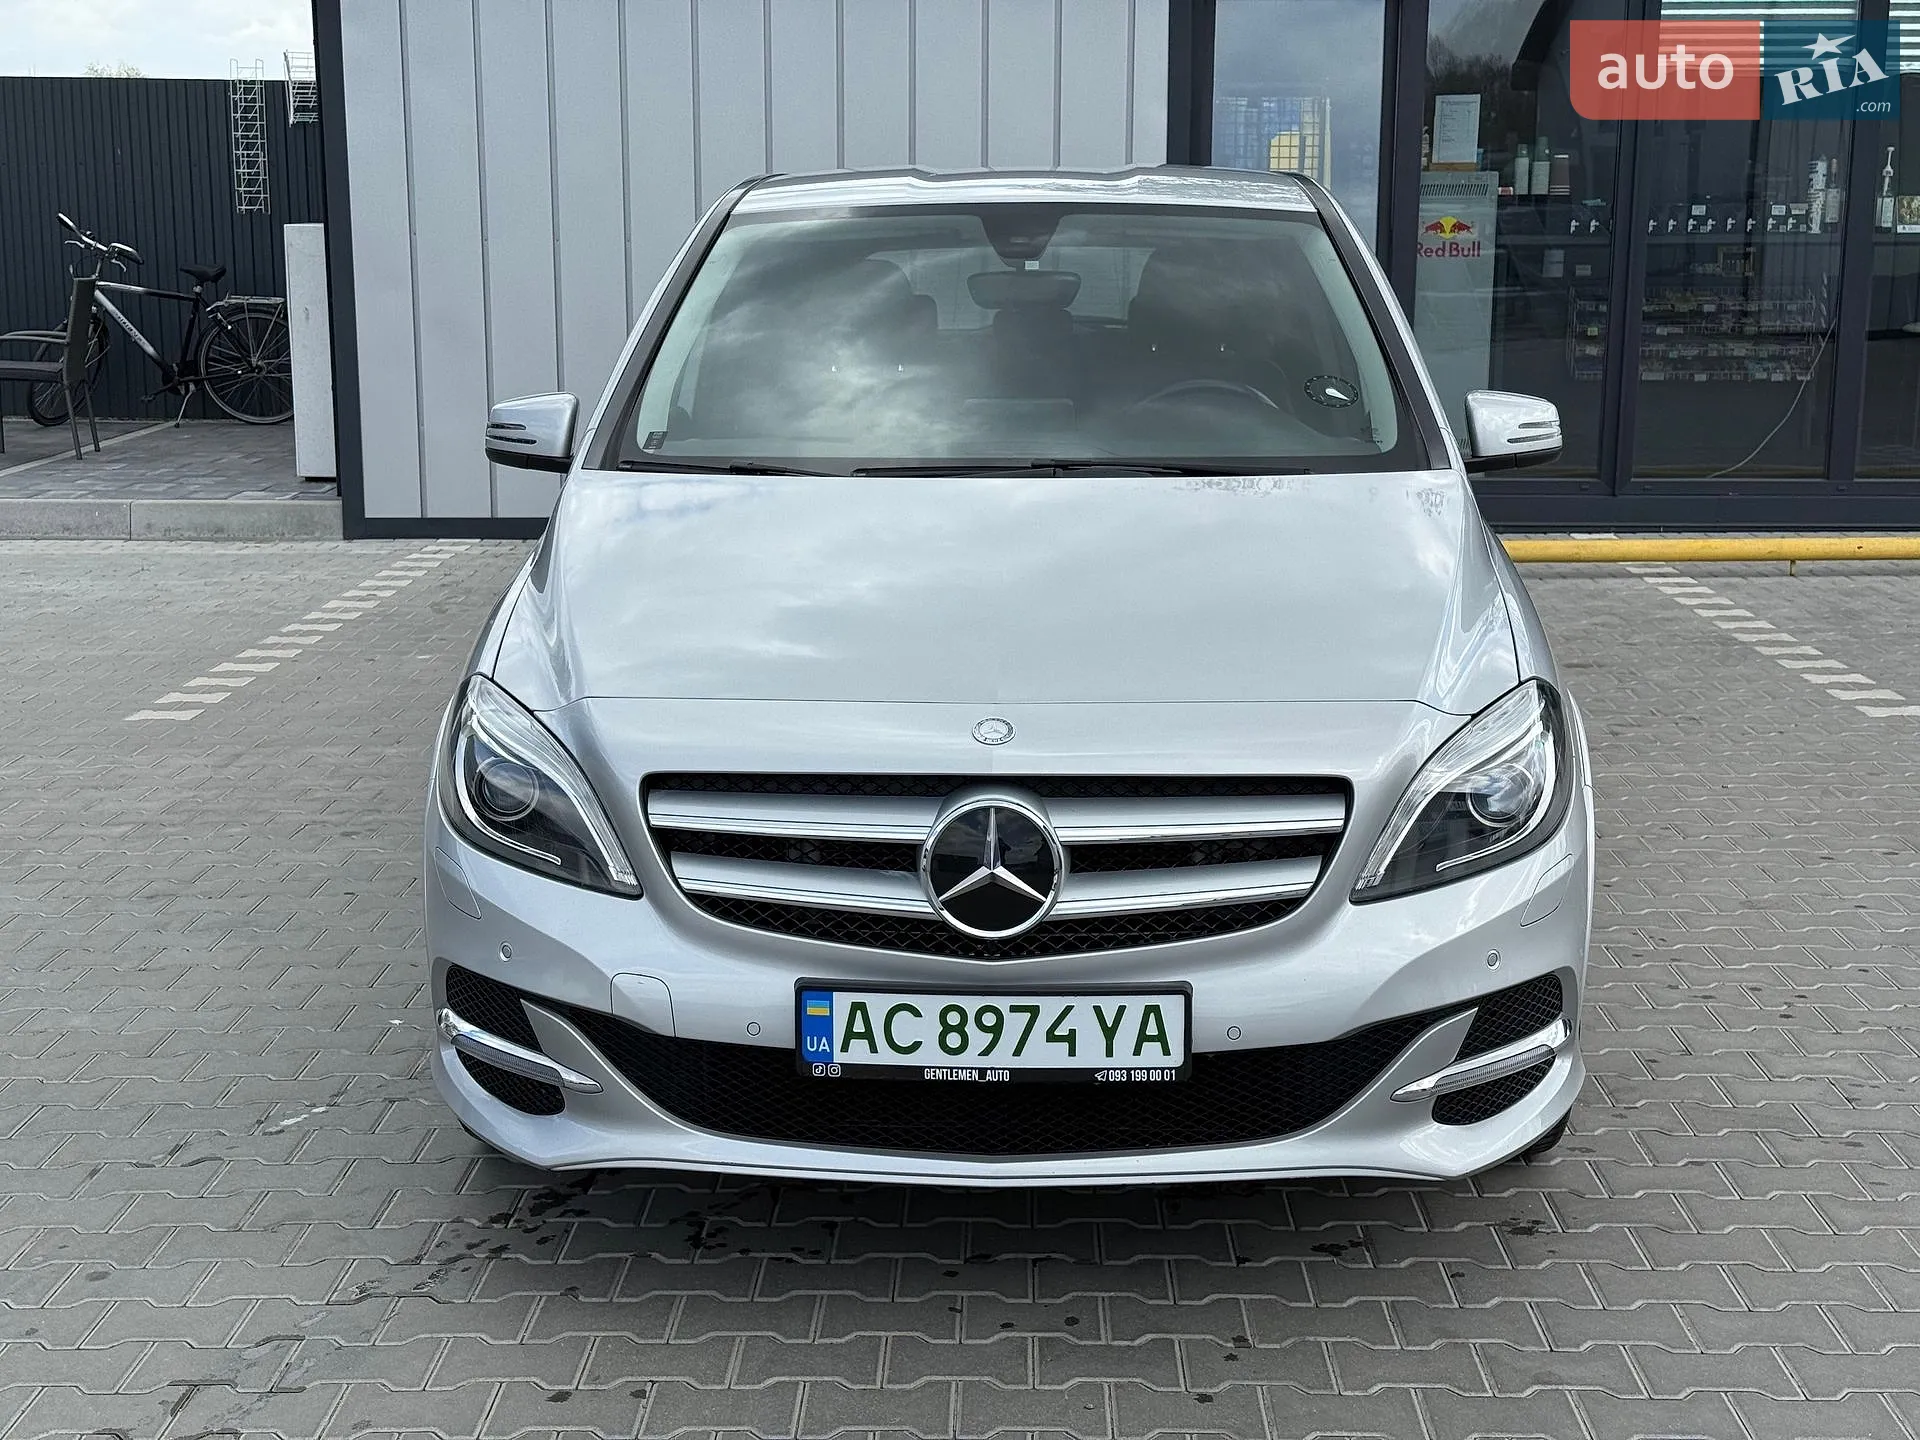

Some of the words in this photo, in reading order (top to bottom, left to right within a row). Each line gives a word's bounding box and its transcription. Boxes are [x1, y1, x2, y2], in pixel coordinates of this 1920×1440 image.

[1449, 241, 1480, 257] Bull
[839, 1001, 924, 1055] AC
[938, 1003, 1077, 1057] 8974
[1092, 1004, 1172, 1058] YA
[806, 1036, 831, 1052] UA
[924, 1068, 1010, 1082] GENTLEMEN_AUTO
[1108, 1069, 1127, 1082] 093
[1130, 1069, 1147, 1081] 199
[1149, 1069, 1162, 1081] 00
[1164, 1069, 1176, 1081] 01
